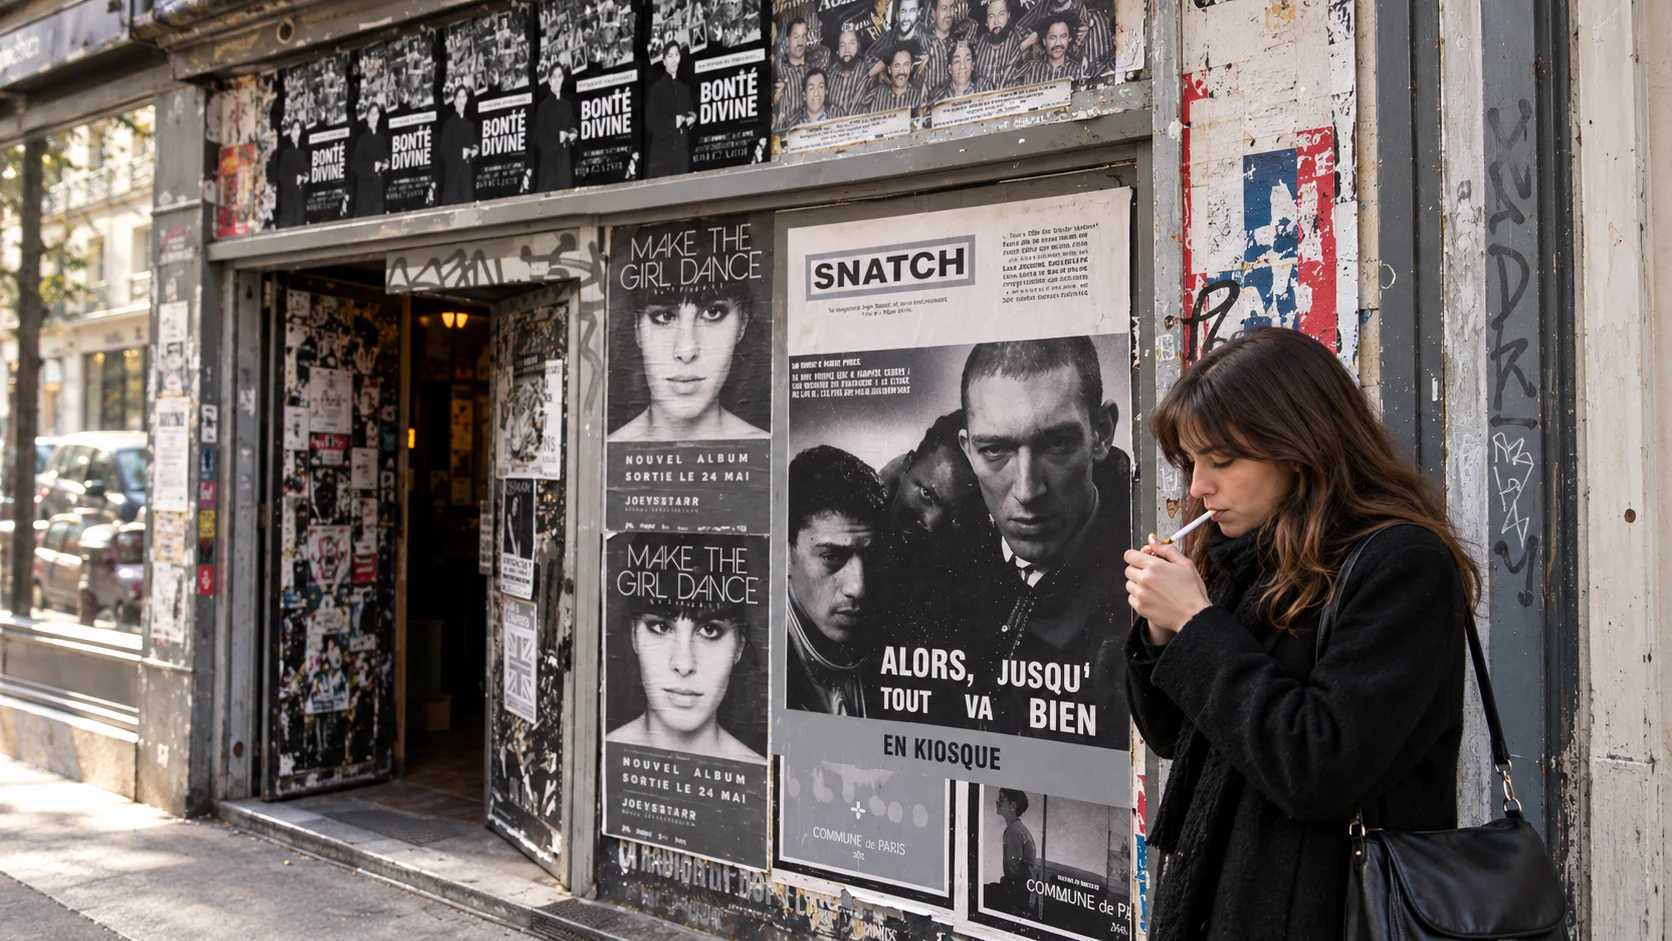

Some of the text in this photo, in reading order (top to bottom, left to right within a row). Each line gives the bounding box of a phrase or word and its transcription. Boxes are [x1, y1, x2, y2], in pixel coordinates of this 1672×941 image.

[580, 110, 632, 140] DIVINE
[700, 95, 758, 125] DIVINE
[391, 148, 432, 171] DIVINE
[481, 132, 526, 157] DIVINE
[311, 161, 345, 184] DIVINE
[631, 223, 752, 261] MAKE THE
[620, 261, 671, 291] GIRL
[680, 251, 762, 285] DANCE
[814, 247, 965, 290] SNATCH
[625, 453, 749, 465] NOUVEL ALBUM
[625, 471, 750, 482] SORTIE LE 24 MAI
[627, 544, 748, 574] MAKE THE
[617, 570, 759, 605] GIRL DANCE
[880, 645, 975, 688] ALORS,
[880, 686, 1097, 737] TOUT VA BIEN
[884, 734, 1001, 771] EN KIOSQUE
[623, 756, 746, 785] NOUVEL ALBUM
[622, 772, 747, 804] SORTIE LE 24 MAI
[812, 826, 863, 848] COMMUNE
[865, 838, 876, 850] de
[878, 839, 906, 856] PARIS
[1026, 878, 1096, 911] COMMUNE
[1098, 899, 1114, 916] de
